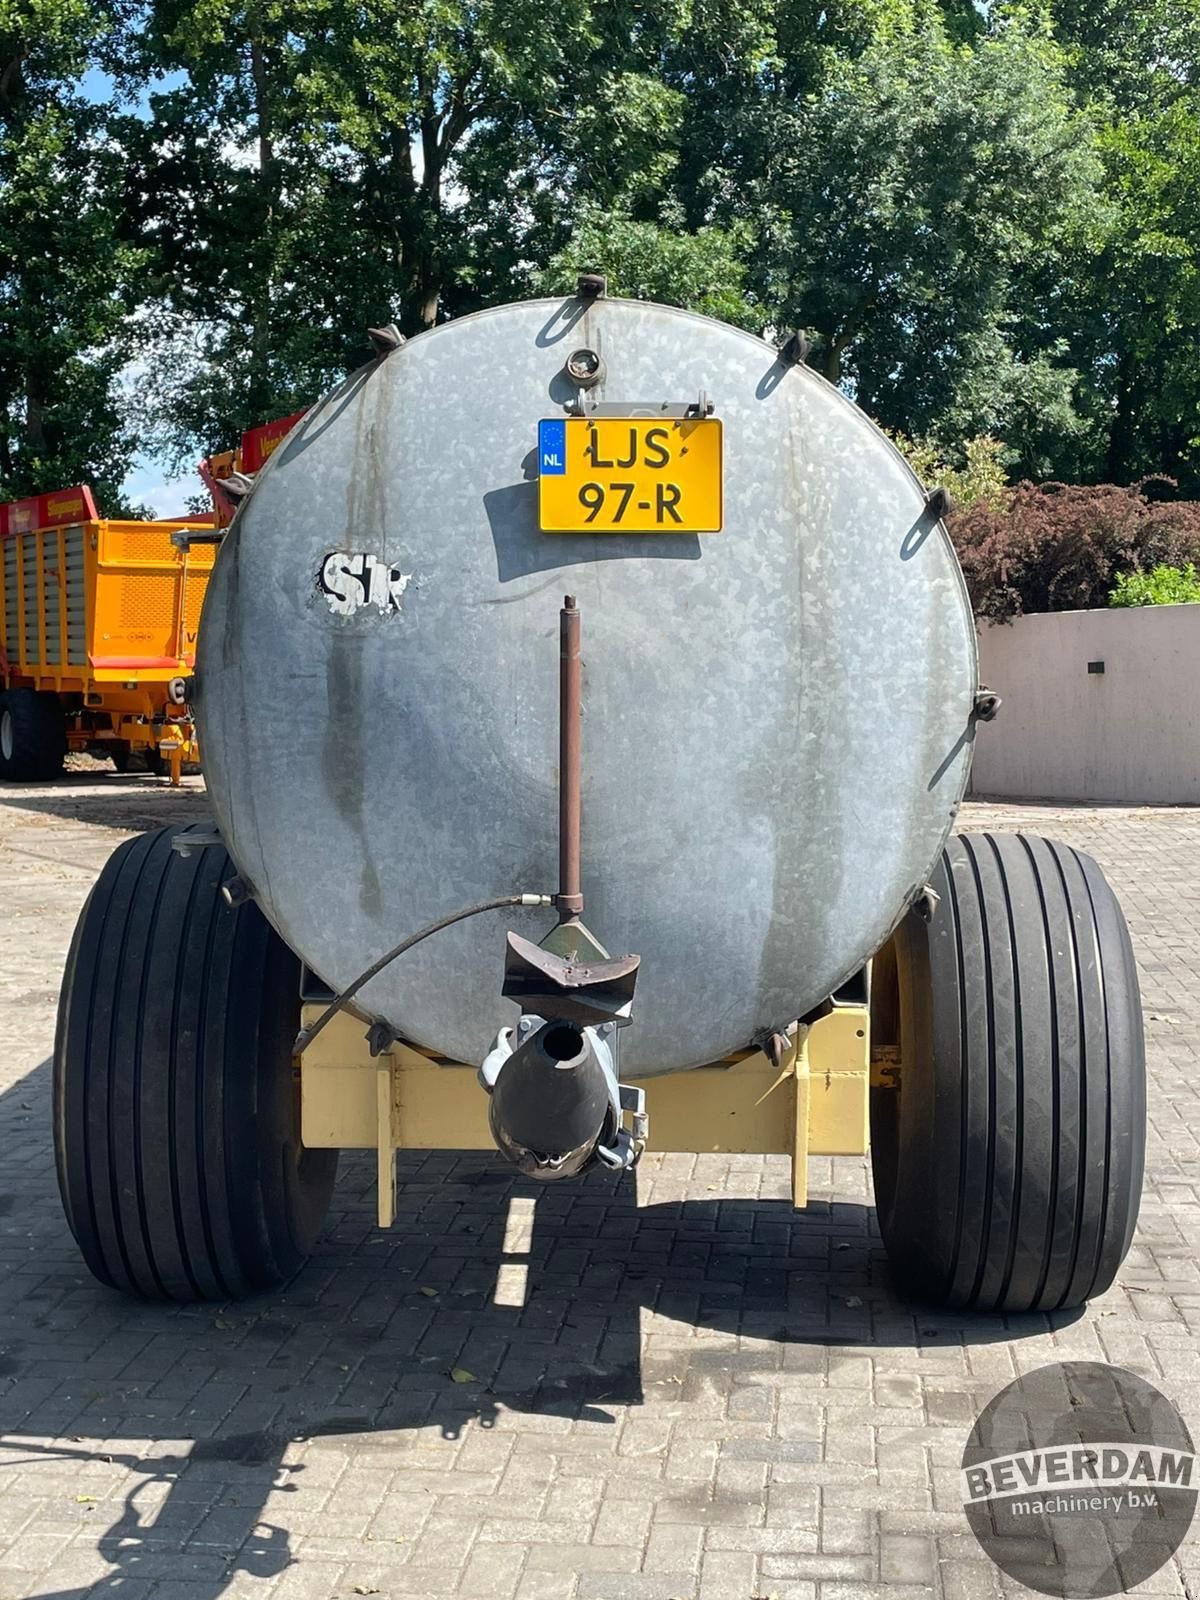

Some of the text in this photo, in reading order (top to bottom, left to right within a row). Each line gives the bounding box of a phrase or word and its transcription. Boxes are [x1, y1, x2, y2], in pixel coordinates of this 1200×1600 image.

[543, 453, 563, 467] NL
[590, 428, 670, 469] LJS
[578, 482, 683, 524] 97-R
